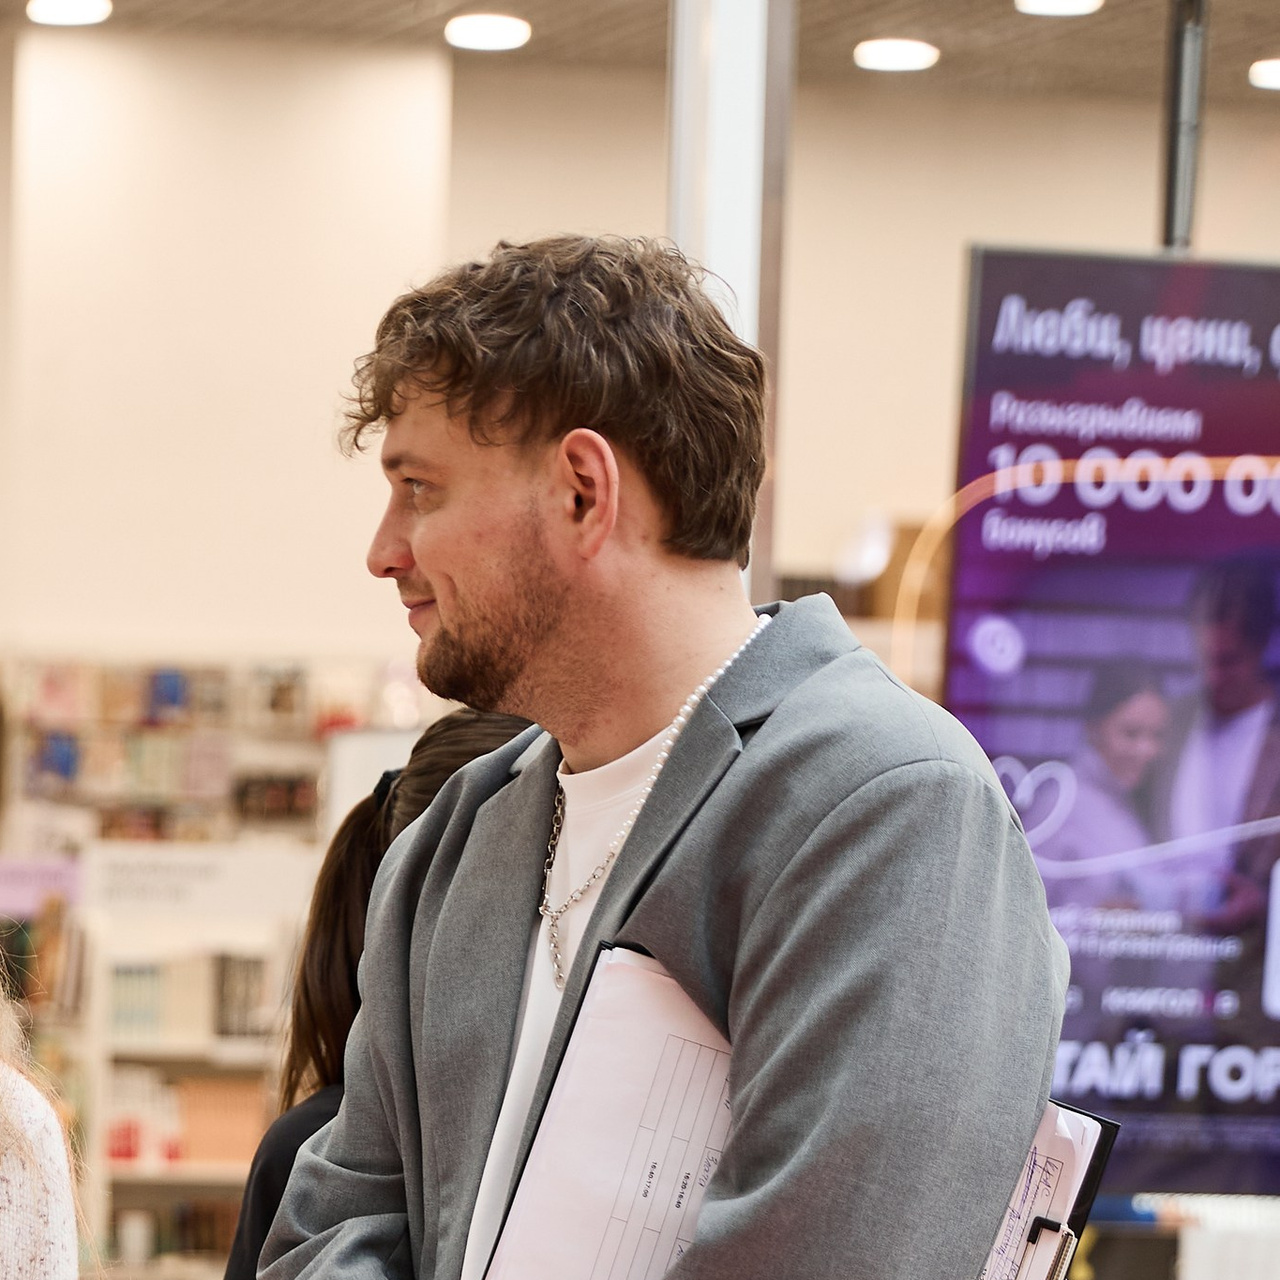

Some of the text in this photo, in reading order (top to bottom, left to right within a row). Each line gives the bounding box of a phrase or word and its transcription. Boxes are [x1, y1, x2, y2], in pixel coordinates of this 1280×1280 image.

[987, 442, 1280, 517] 10 000 0
